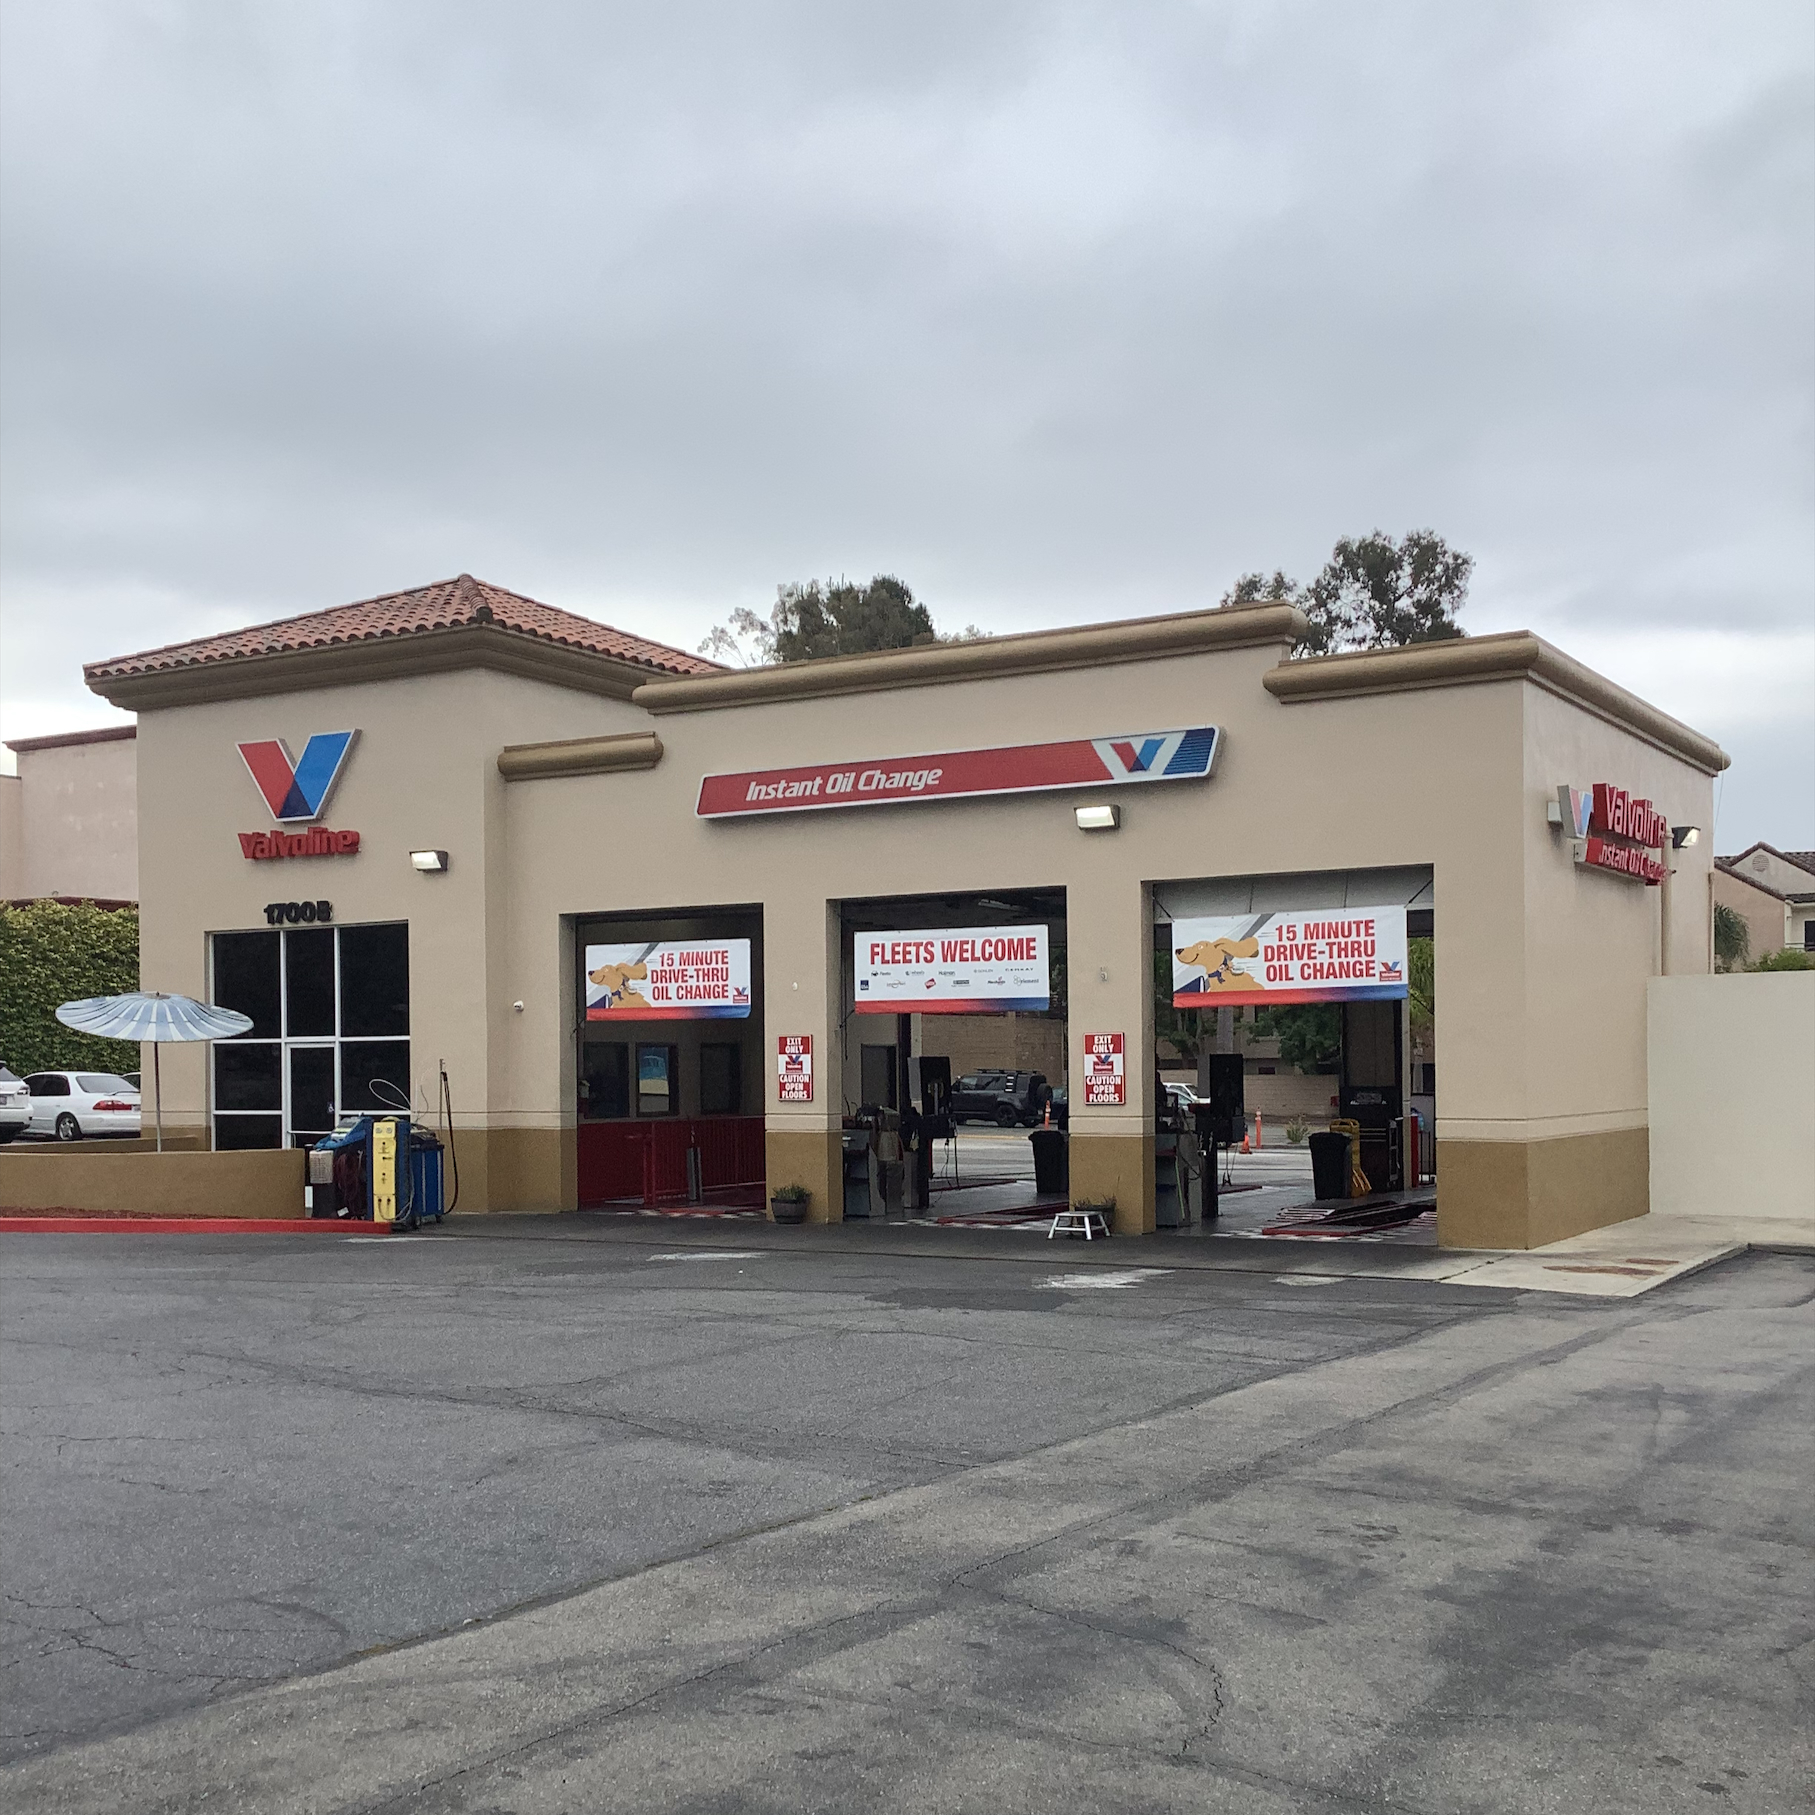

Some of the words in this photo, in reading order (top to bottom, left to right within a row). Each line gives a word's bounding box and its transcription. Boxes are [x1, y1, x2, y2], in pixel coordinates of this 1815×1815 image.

[746, 778, 823, 802] Instant
[825, 772, 857, 794] Oil
[857, 768, 943, 792] Change
[1594, 783, 1667, 849] Valvoline
[238, 827, 360, 860] Valvoline
[263, 900, 333, 925] 1700B
[1275, 923, 1297, 942] 15
[1303, 919, 1375, 941] MINUTE
[659, 952, 674, 967] 15
[678, 950, 729, 966] MINUTE
[869, 941, 935, 965] FLEETS
[940, 937, 1037, 963] WELCOME
[1263, 939, 1376, 963] DRIVE-THRU
[650, 967, 729, 984] DRIVE-THRU
[1265, 963, 1295, 983] OIL
[1299, 960, 1376, 980] CHANGE
[652, 985, 673, 1001] OIL
[676, 984, 729, 1000] CHANGE
[786, 1037, 802, 1045] EXIT
[1094, 1035, 1113, 1044] EXIT
[785, 1045, 804, 1054] ONLY
[1092, 1044, 1114, 1053] ONLY
[780, 1074, 810, 1083] CAUTION
[785, 1082, 804, 1091] OPEN
[1086, 1076, 1122, 1085] CAUTION
[781, 1091, 808, 1099] FLOORS
[1088, 1093, 1120, 1102] FLOORS
[1093, 1085, 1115, 1094] OPEN
